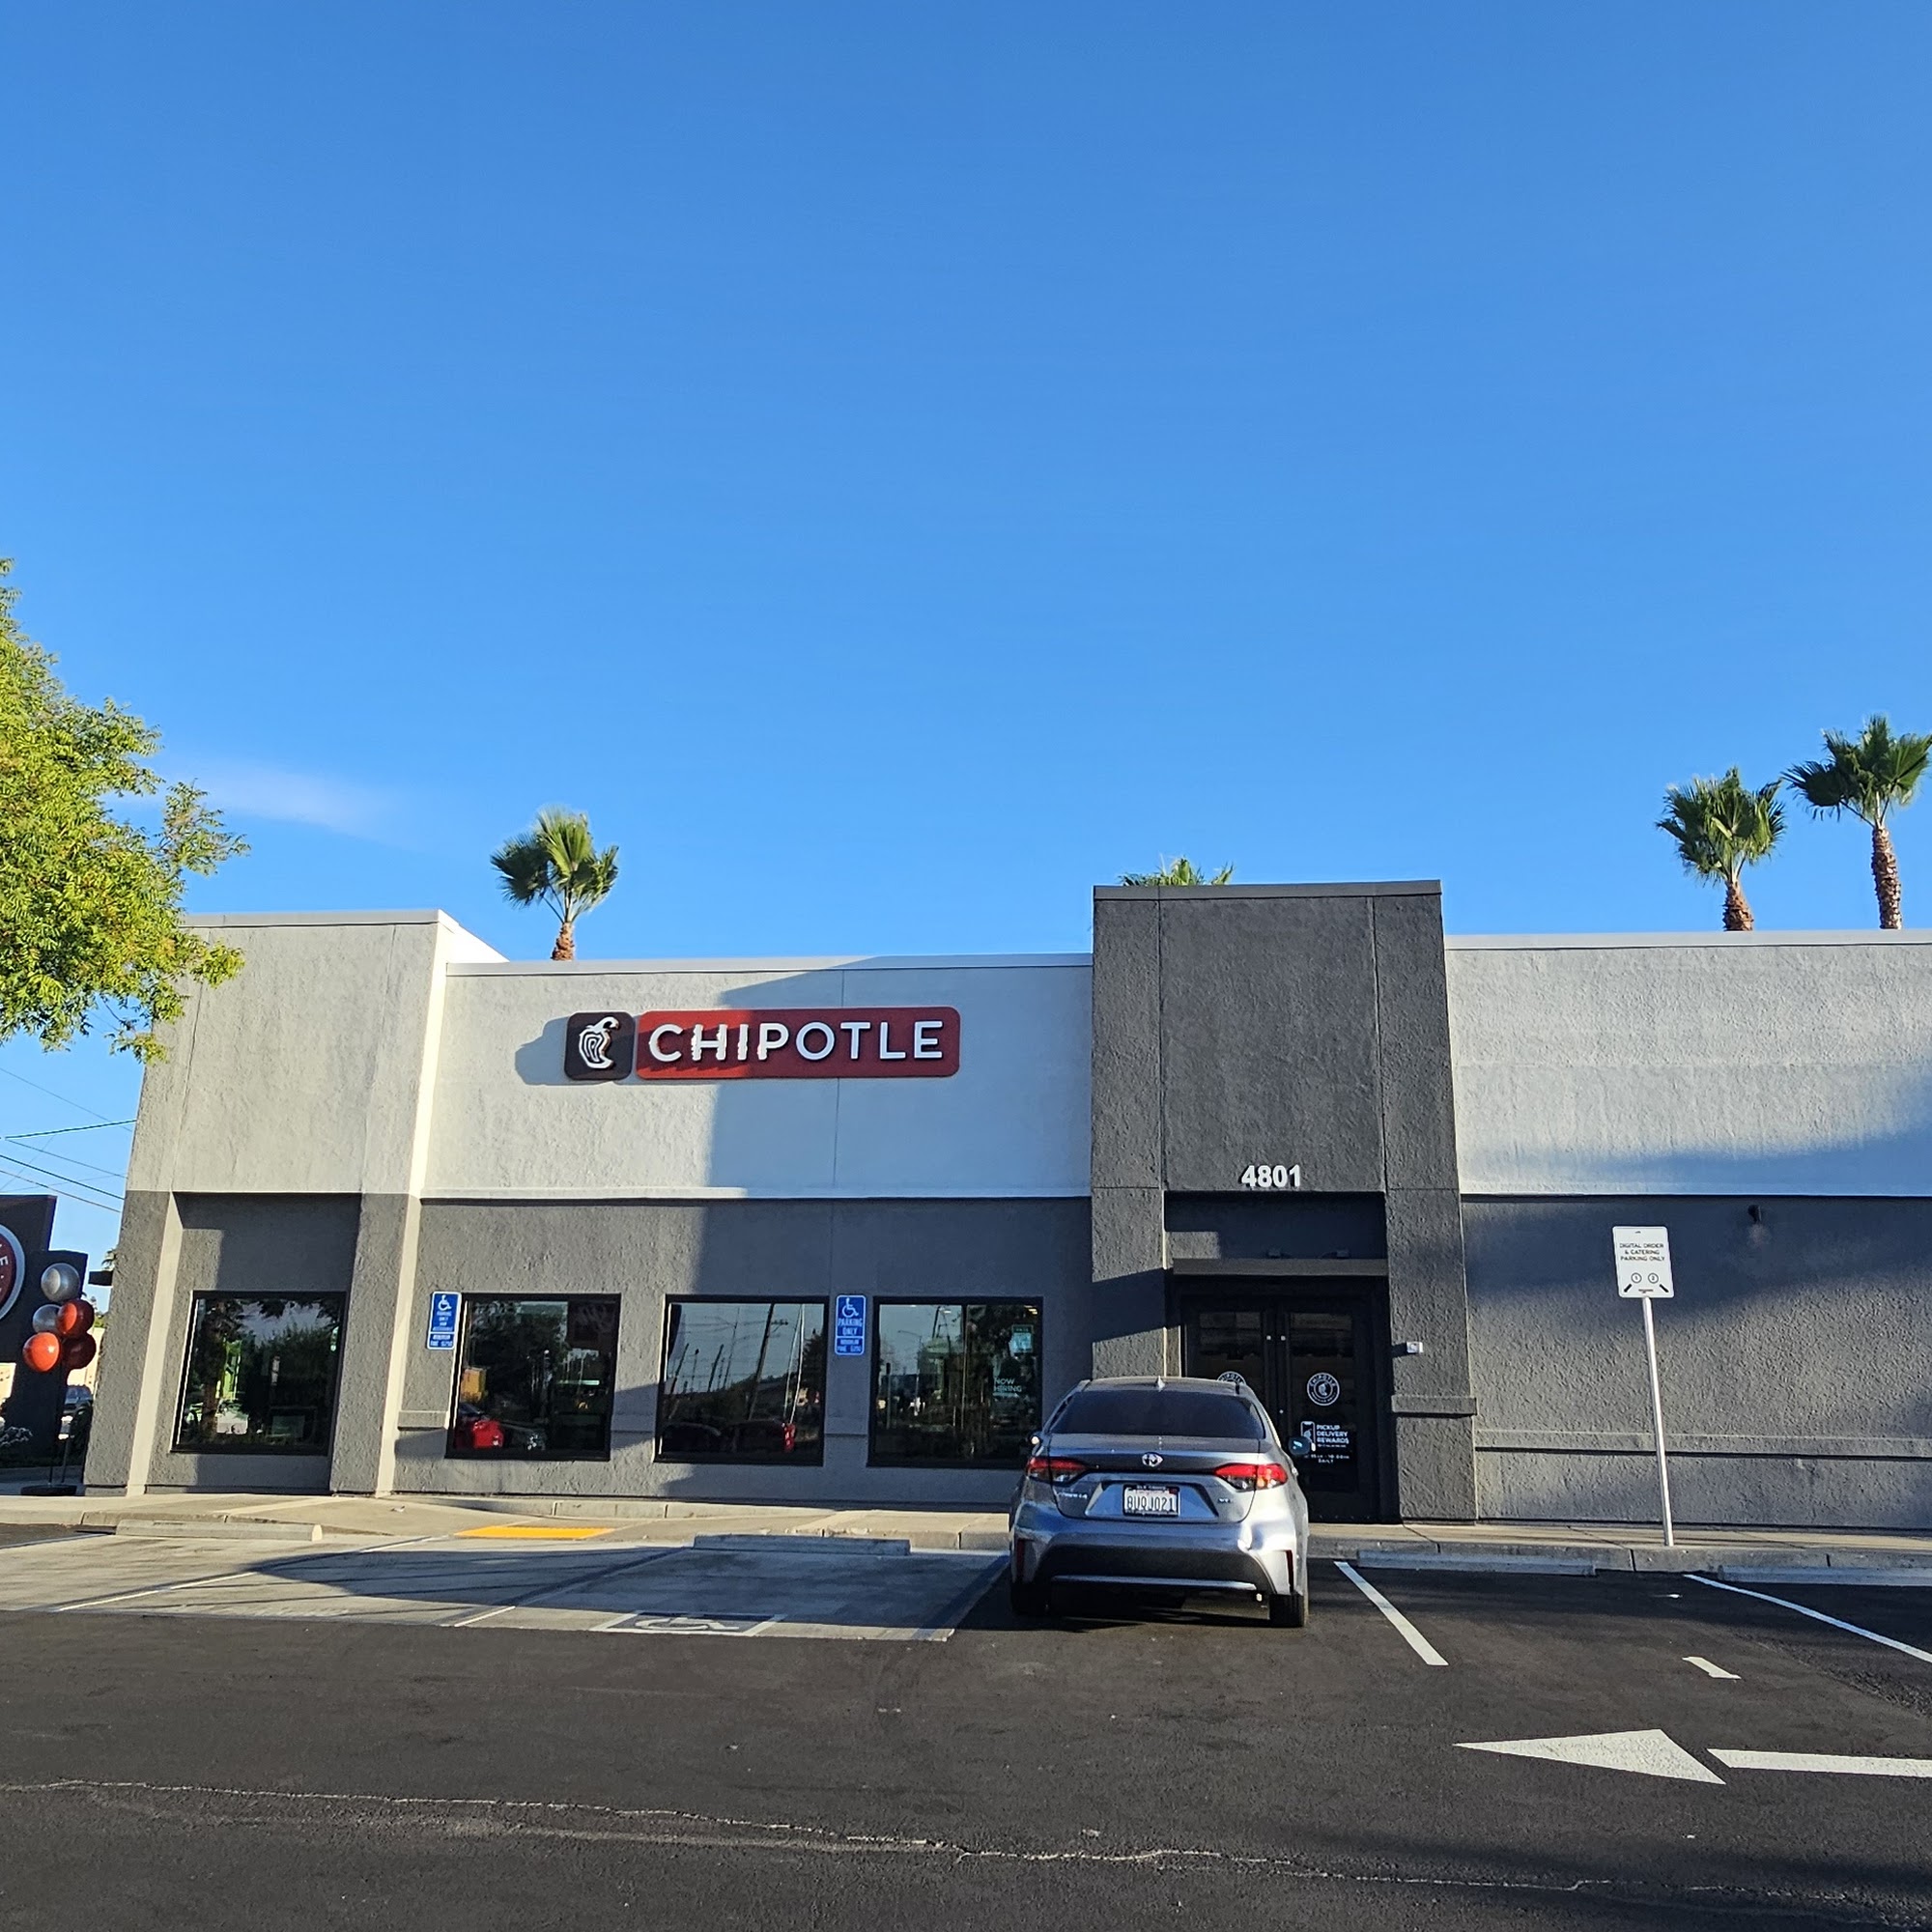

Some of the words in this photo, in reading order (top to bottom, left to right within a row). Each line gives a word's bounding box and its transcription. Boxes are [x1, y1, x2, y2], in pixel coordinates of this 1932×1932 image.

[648, 1020, 944, 1062] CHIPOTLE
[1240, 1164, 1300, 1187] 4801
[838, 1318, 863, 1326] PARKING
[842, 1327, 858, 1336] ONLY
